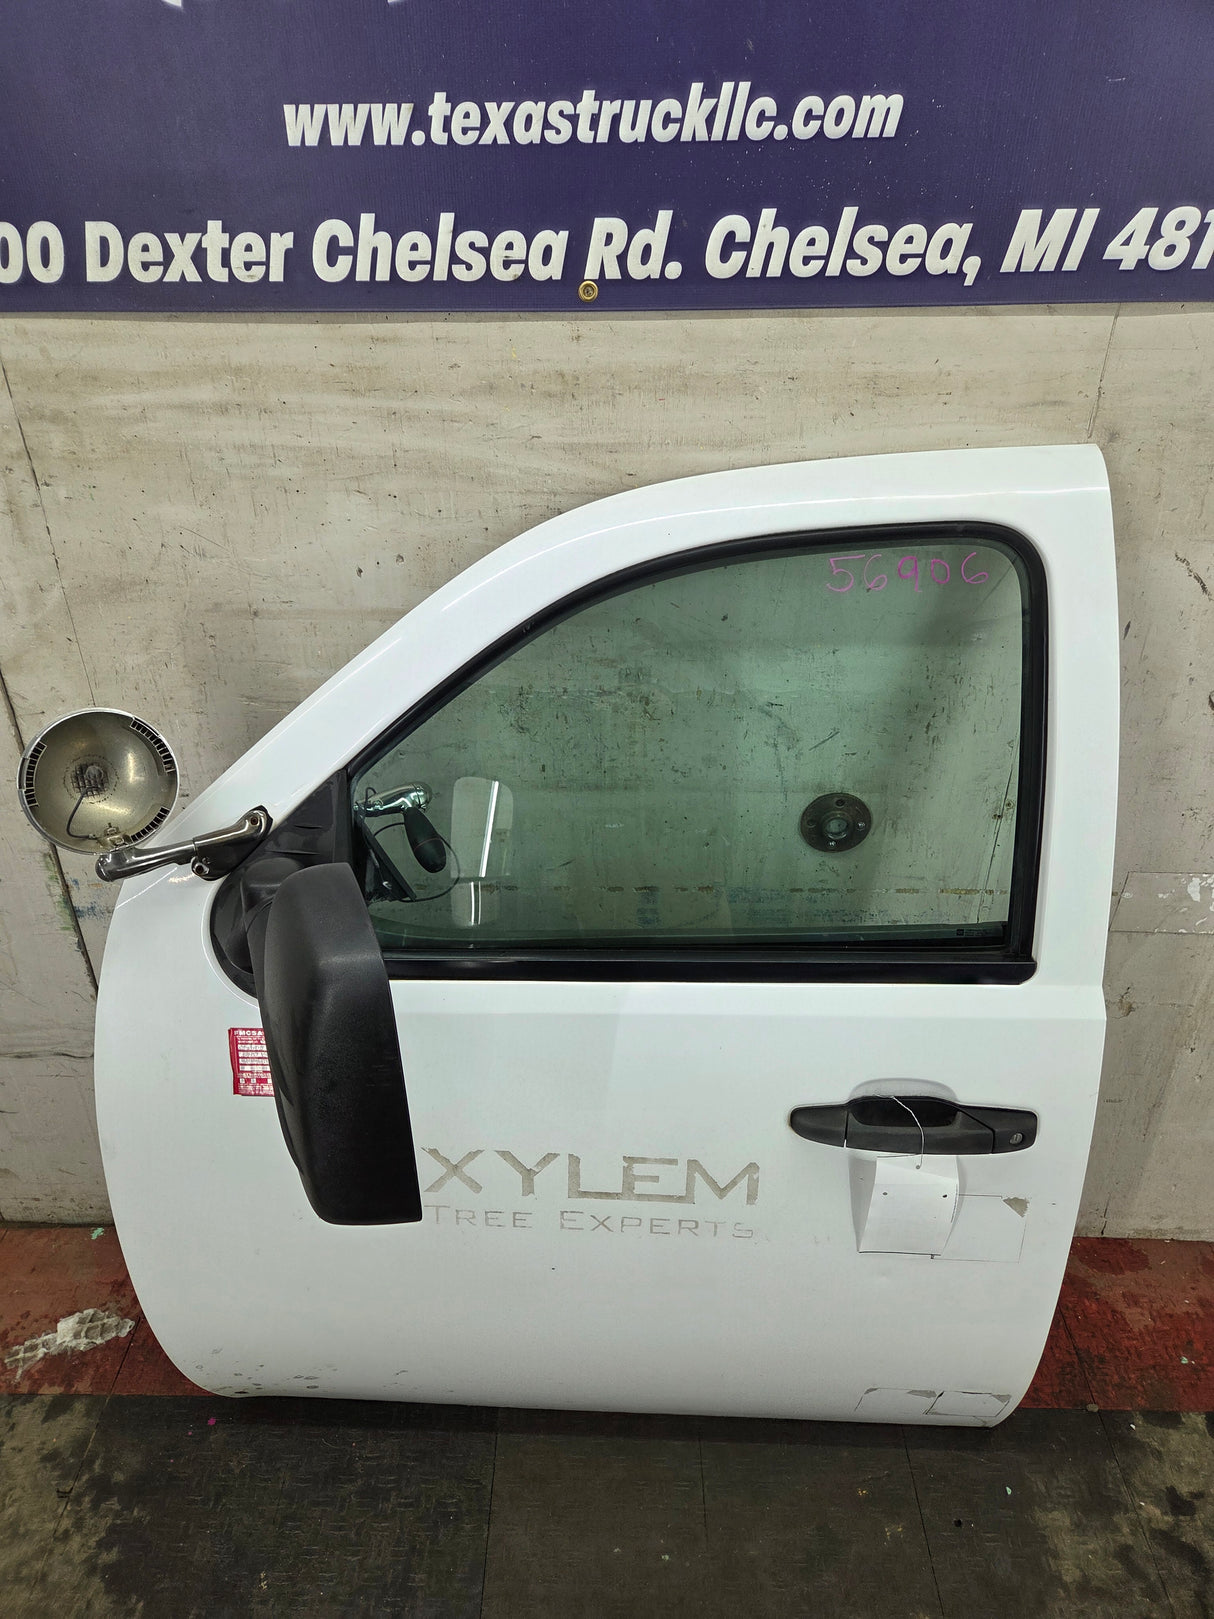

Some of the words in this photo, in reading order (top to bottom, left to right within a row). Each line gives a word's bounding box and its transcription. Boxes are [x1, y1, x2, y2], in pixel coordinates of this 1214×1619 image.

[283, 81, 904, 147] www.texastruckllc.com
[85, 219, 294, 283] Dexter
[312, 212, 569, 283] Chelsea
[583, 209, 683, 281] Rd.
[705, 206, 982, 287] Chelsea,
[999, 208, 1101, 273] MI
[826, 551, 989, 592] 56906
[421, 1147, 760, 1205] XYLEM
[424, 1204, 533, 1229] TREE
[559, 1210, 754, 1239] EXPERTS
